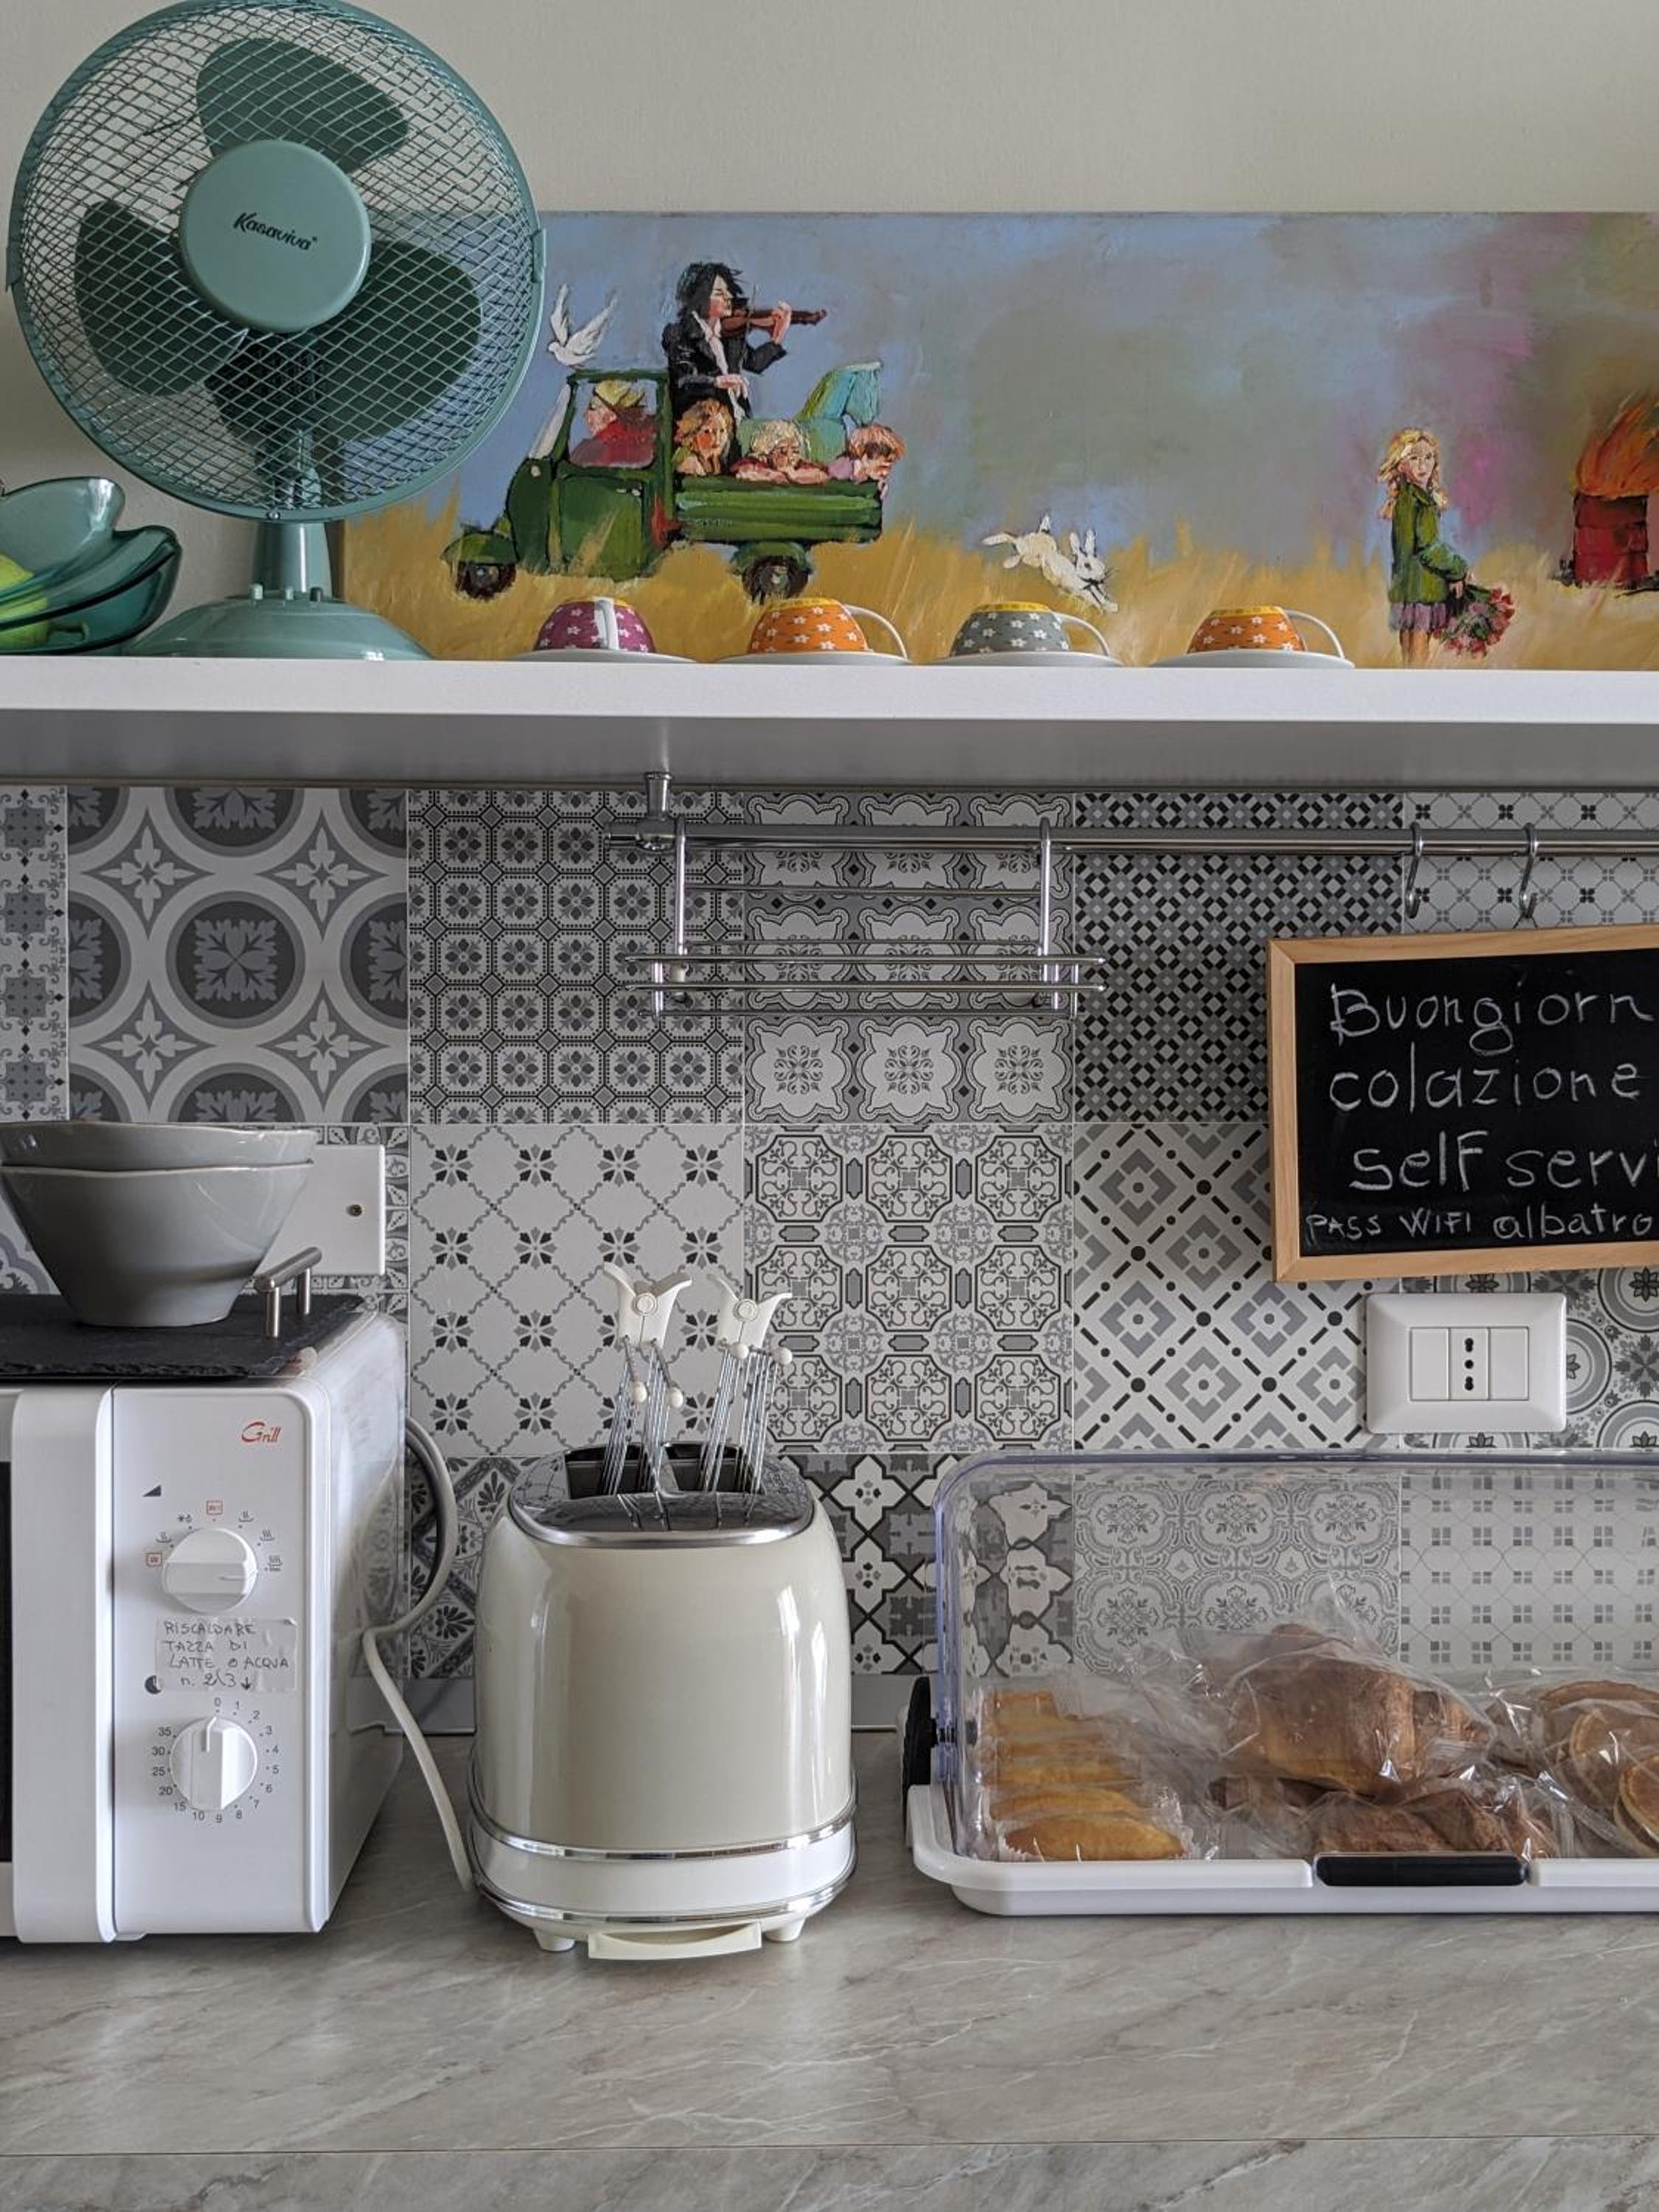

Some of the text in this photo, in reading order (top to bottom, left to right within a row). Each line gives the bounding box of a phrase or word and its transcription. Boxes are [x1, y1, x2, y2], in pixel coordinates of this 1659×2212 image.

[1329, 1041, 1641, 1113] colazione
[1305, 1214, 1382, 1245] PASS
[241, 1421, 282, 1443] Grill
[164, 1621, 257, 1636] RISCALDARE
[163, 1641, 214, 1652] TAZZA
[169, 1654, 215, 1669] LATTE
[244, 1658, 288, 1669] ACQUA
[214, 1697, 221, 1707] 0
[235, 1702, 240, 1710] 1
[253, 1711, 260, 1719] 2
[159, 1728, 172, 1736] 35
[266, 1726, 272, 1735] 3
[151, 1747, 165, 1756] 30
[273, 1745, 279, 1753] 4
[153, 1767, 166, 1775] 25
[273, 1766, 279, 1774] 5
[159, 1786, 173, 1795] 20
[265, 1784, 272, 1793] 6
[174, 1801, 186, 1812] 15
[254, 1800, 260, 1809] 7
[193, 1810, 205, 1820] 10
[236, 1810, 242, 1819] 8
